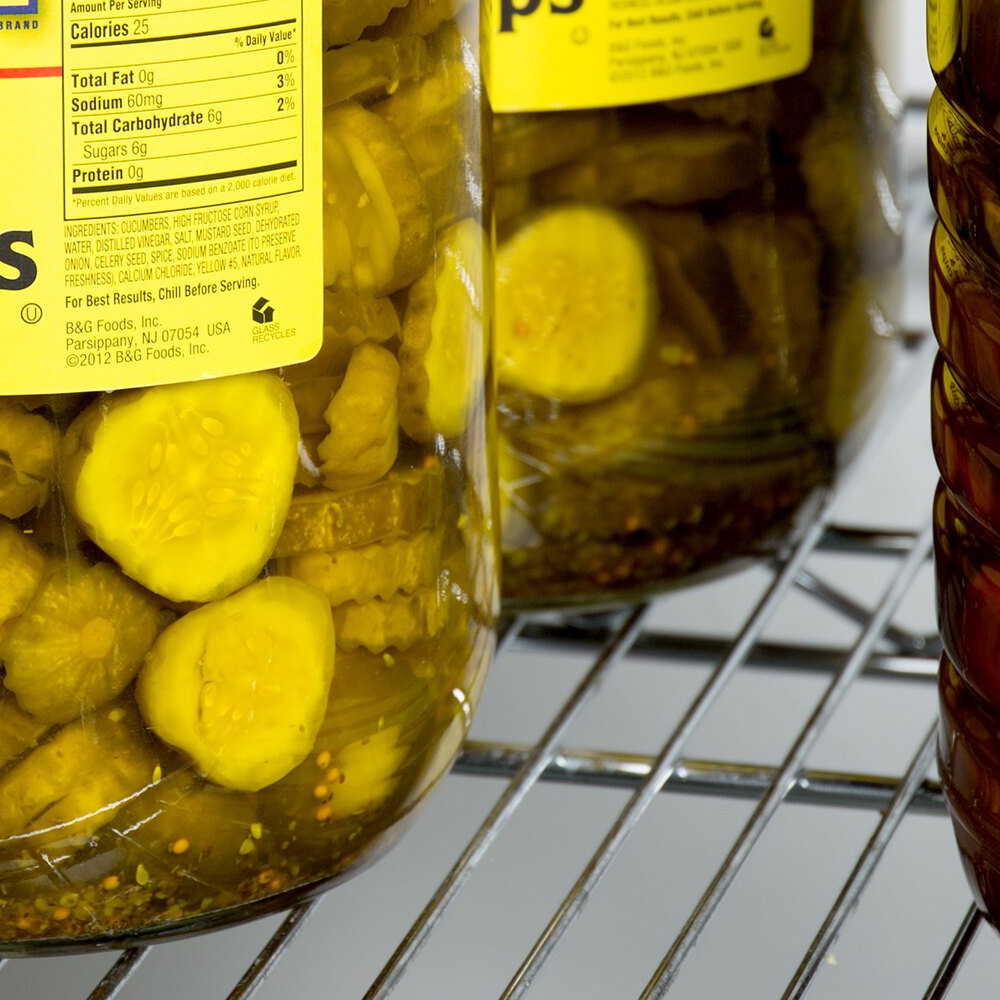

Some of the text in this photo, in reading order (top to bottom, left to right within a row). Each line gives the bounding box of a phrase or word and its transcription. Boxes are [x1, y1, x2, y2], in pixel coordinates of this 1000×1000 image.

[70, 0, 106, 14] Amount
[110, 0, 124, 10] Per
[71, 19, 149, 40] Calories 25
[246, 33, 266, 47] Daily
[277, 50, 294, 65] 0%
[72, 69, 154, 88] Total Fat 0g
[277, 74, 295, 88] 3%
[72, 93, 163, 112] Sodium 60mg
[277, 97, 295, 112] 2%
[72, 109, 222, 135] Total Carbohydrate 6g
[84, 140, 147, 160] Sugars 6g
[73, 165, 143, 183] Protein 0g
[112, 195, 132, 206] Daily
[136, 192, 163, 203] Values
[165, 190, 179, 200] are
[181, 186, 206, 198] based
[208, 185, 218, 194] on
[221, 185, 225, 193] a
[252, 176, 277, 187] calorie
[64, 222, 119, 238] INGREDIENTS:
[174, 214, 191, 228] HIGH
[194, 208, 232, 224] FRUCTOSE
[96, 237, 135, 253] DISTILLED
[196, 225, 231, 241] MUSTARD
[256, 213, 300, 233] DEHYDRATED
[95, 253, 124, 269] CELERY
[177, 245, 206, 261] SODIUM
[209, 238, 246, 256] BENZOATE
[262, 230, 296, 247] PRESERVE
[119, 268, 153, 284] CALCIUM
[197, 259, 226, 274] YELLOW
[241, 252, 273, 268] NATURAL
[65, 276, 260, 308] For Best Results, Chill Before Serving.
[66, 315, 162, 334] B&G Foods, Inc.
[252, 323, 280, 335] GLASS
[66, 321, 230, 351] Parsippany, NJ 07054 USA
[252, 329, 296, 344] RECYCLES
[116, 350, 142, 363] B&G
[146, 346, 184, 360] Foods,
[189, 343, 209, 355] Inc.
